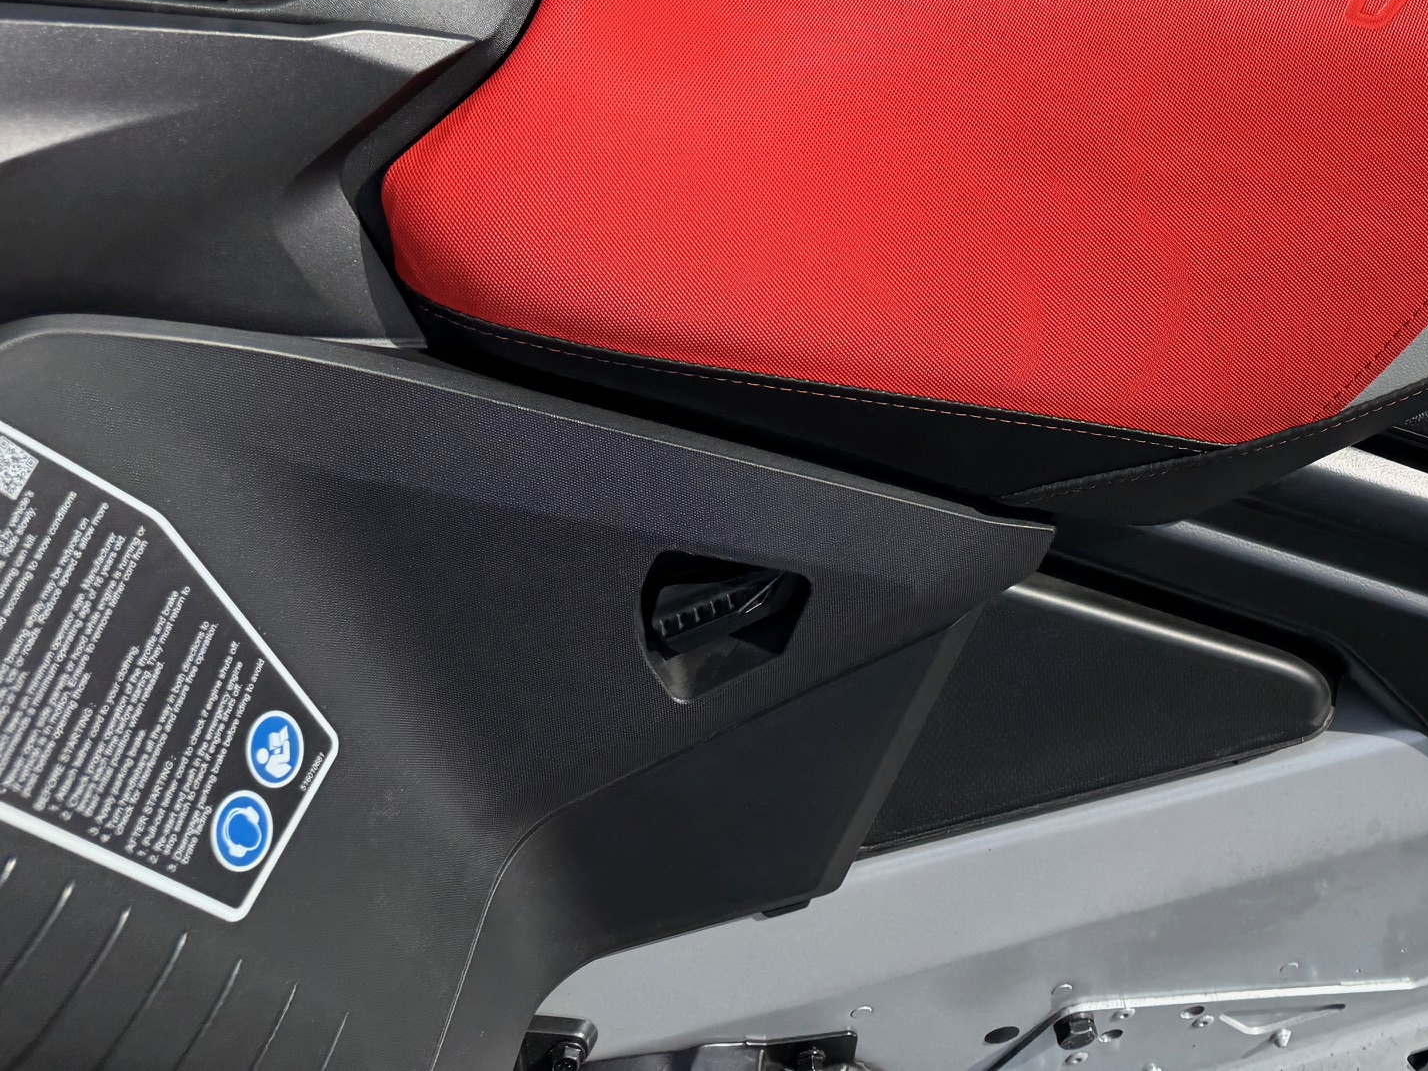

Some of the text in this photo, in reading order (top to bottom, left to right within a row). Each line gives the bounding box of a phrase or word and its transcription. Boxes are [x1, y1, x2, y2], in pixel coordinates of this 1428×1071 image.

[49, 491, 77, 535] conditions
[161, 591, 179, 616] brake
[182, 631, 205, 672] directions
[251, 658, 265, 683] avoid
[190, 718, 206, 745] check
[205, 680, 223, 710] engine
[219, 655, 233, 679] shuts
[34, 707, 93, 811] BEFORE STARTING
[125, 760, 174, 853] AFTER STARTING
